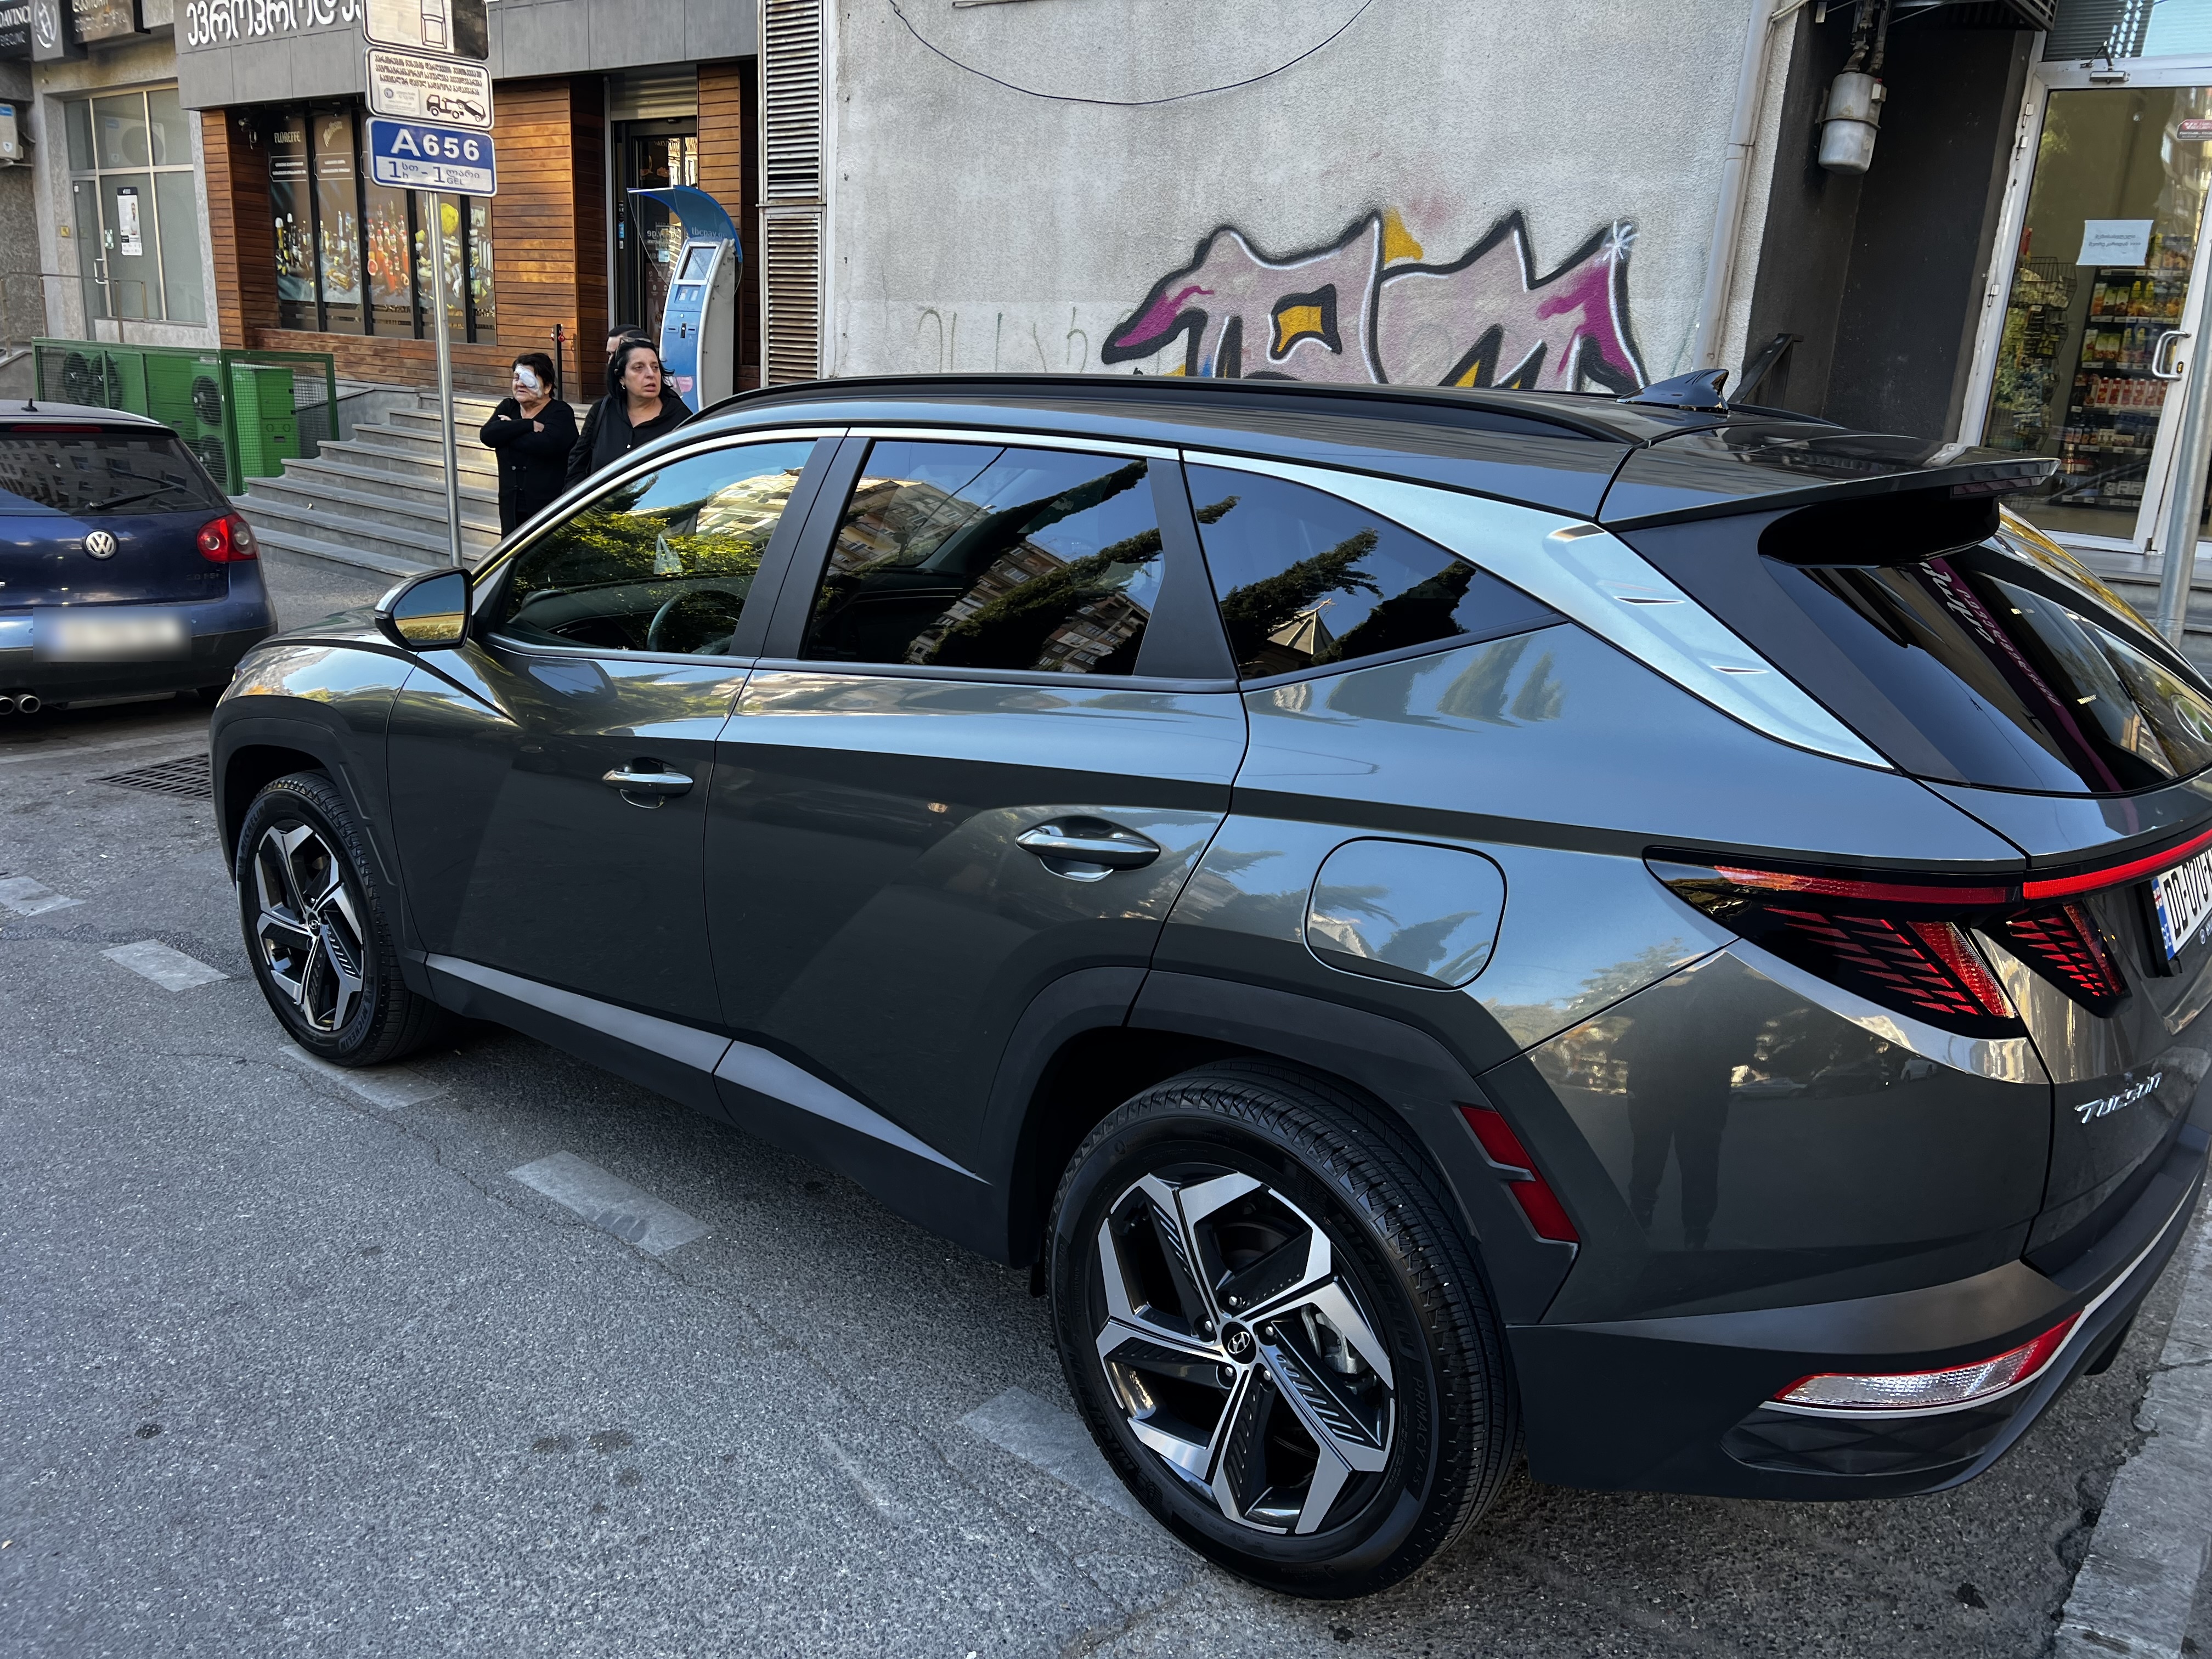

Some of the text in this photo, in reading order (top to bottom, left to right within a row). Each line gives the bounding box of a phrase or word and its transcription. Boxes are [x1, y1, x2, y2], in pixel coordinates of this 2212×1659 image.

[274, 131, 301, 143] FLOREFFE
[388, 161, 402, 178] 1
[402, 162, 419, 171] სთ
[433, 166, 445, 183] 1
[446, 169, 480, 179] ლარი
[447, 177, 465, 185] GEL
[691, 227, 727, 240] tbcpay.ge
[2163, 847, 2212, 940] DD-070-
[1412, 1376, 1429, 1460] PRIMACY
